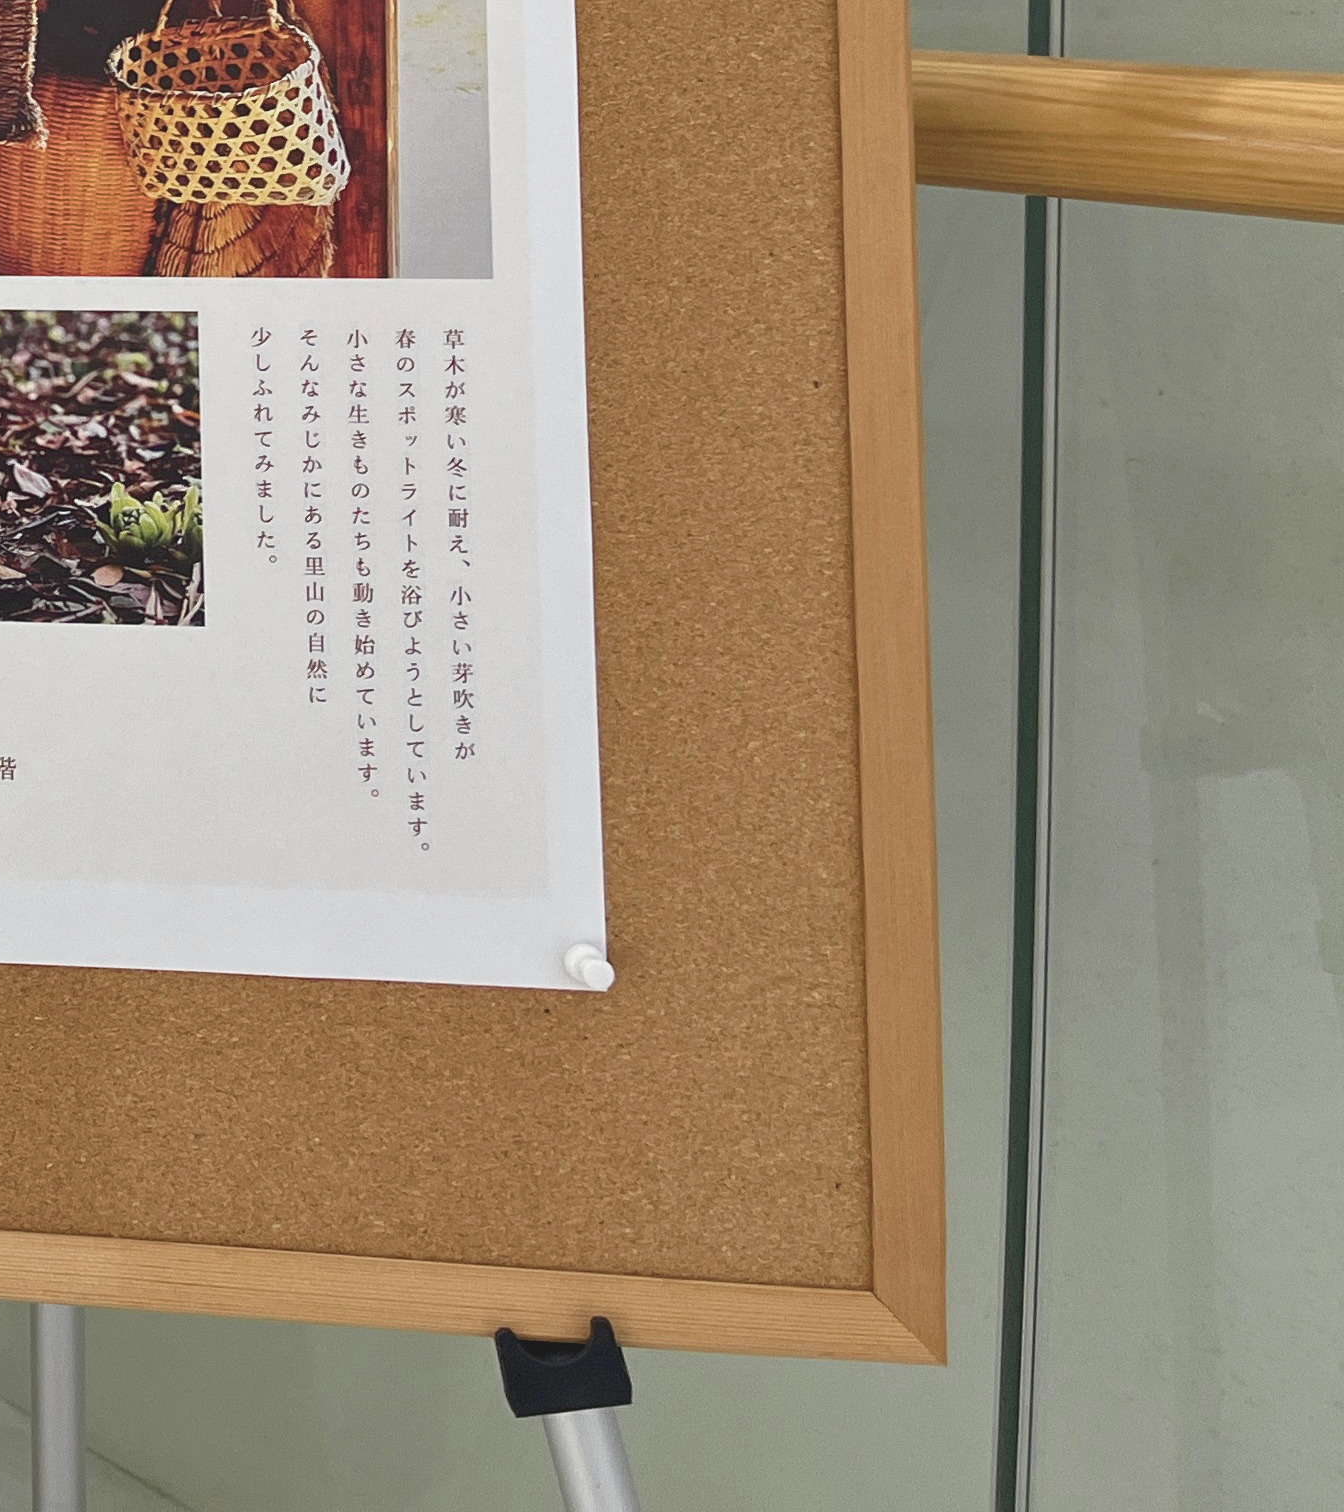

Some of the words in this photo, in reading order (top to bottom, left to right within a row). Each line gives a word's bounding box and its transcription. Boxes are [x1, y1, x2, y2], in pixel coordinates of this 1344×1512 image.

[251, 327, 277, 563] 少しふれてみました。
[300, 329, 328, 703] そんなみじかにある里山の自然に
[347, 329, 379, 797] 小さな生きものたちも動き始めています。
[396, 329, 430, 851] 春のスポットライトを浴びようとしています。
[444, 329, 475, 760] 草木が寒い冬に耐え、小さい芽吹きが
